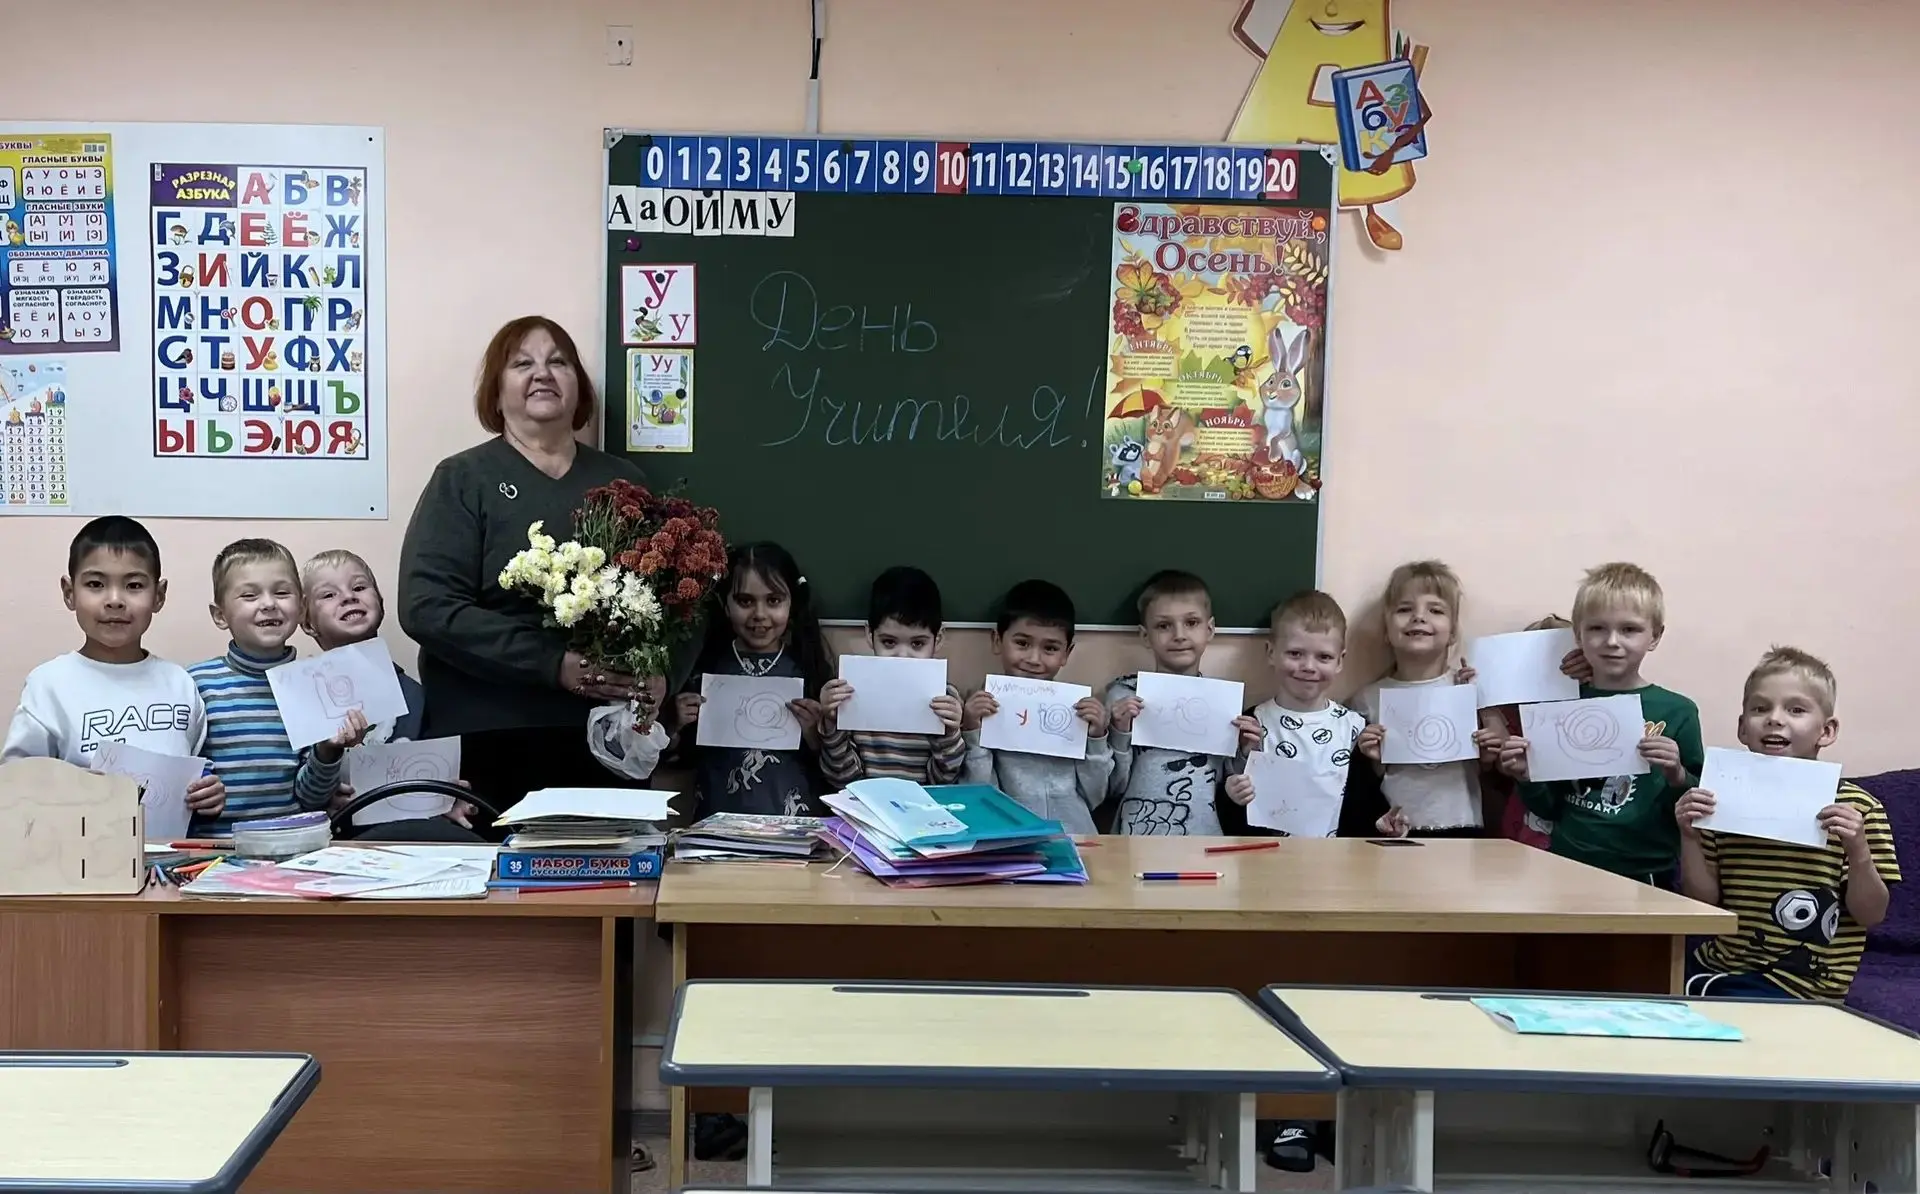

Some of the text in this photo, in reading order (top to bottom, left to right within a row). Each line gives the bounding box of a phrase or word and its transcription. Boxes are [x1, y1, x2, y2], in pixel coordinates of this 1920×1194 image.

[25, 170, 102, 179] А У О Ы Э
[172, 170, 236, 190] РАЗРЕЗНАЯ
[647, 147, 1296, 192] 0 1 2 3 4 5 6 7 8 9 10 11 12 13 14 15 16 17 18 19 20
[26, 184, 102, 195] Я Ю Ё И Е
[176, 188, 230, 200] АЗБУКА
[242, 173, 350, 206] А Б В
[157, 211, 360, 248] Г Д Е Ё Ж
[1116, 204, 1327, 244] Здравствуй,
[16, 262, 100, 272] Е Ё Ю Я
[157, 251, 360, 288] З И Й К Л
[1155, 242, 1284, 276] Осень!
[14, 310, 56, 321] Е Ё И
[68, 312, 106, 320] А О У
[157, 296, 352, 332] М Н О П Р
[750, 270, 938, 352] День
[20, 329, 48, 338] Ю Я
[75, 328, 102, 337] Ы Э
[158, 335, 354, 372] С Т У Ф Х
[159, 377, 360, 414] Ц Ч Ш Щ Ъ
[759, 364, 1100, 450] Учителя!
[1205, 416, 1246, 428] НОЯБРЬ
[159, 419, 353, 454] Ы Ь Э Ю Я
[82, 704, 190, 740] RACE
[510, 860, 522, 870] 35
[531, 858, 630, 868] НАБОР БУКВ
[1280, 1128, 1304, 1137] NIKE
